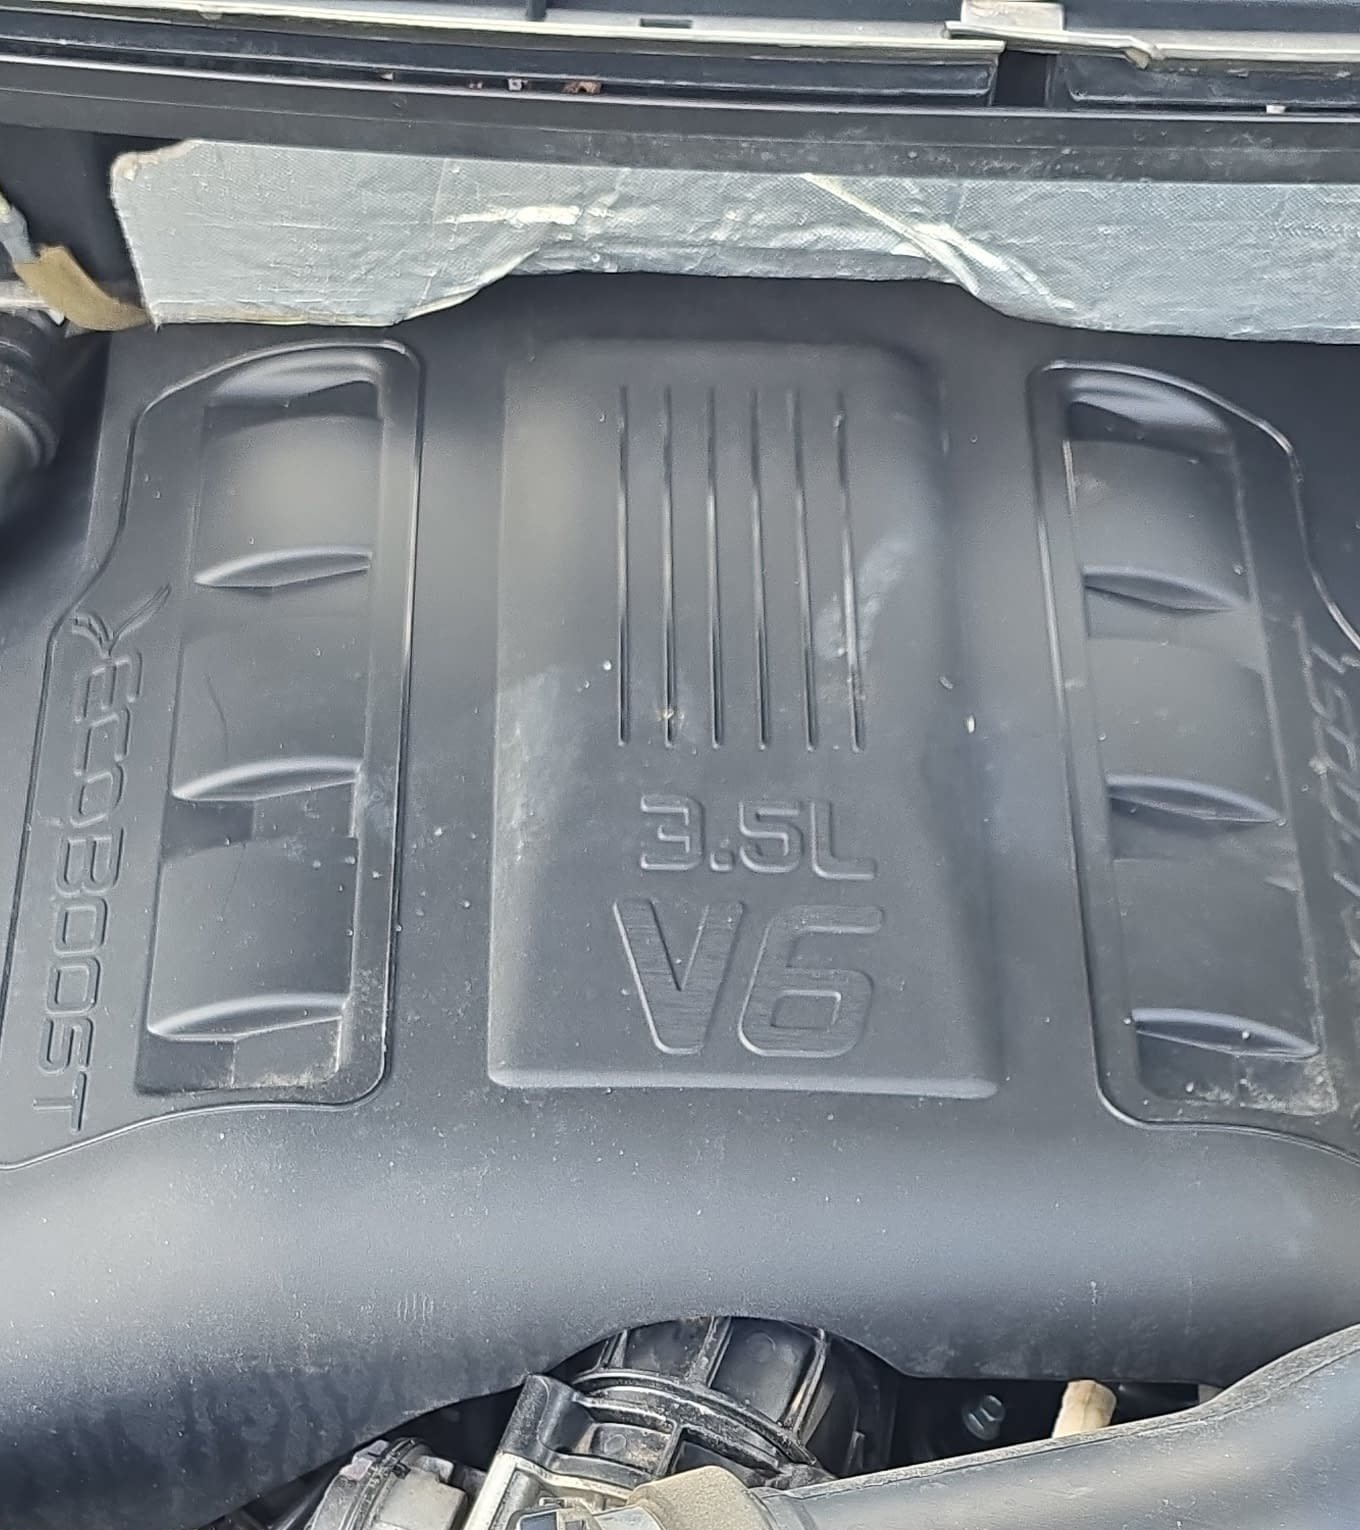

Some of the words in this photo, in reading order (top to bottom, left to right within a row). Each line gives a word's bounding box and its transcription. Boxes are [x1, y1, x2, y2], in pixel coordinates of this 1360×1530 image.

[34, 655, 143, 1136] ECOBOOST
[640, 795, 878, 881] 3.5L
[612, 898, 886, 1059] V6
